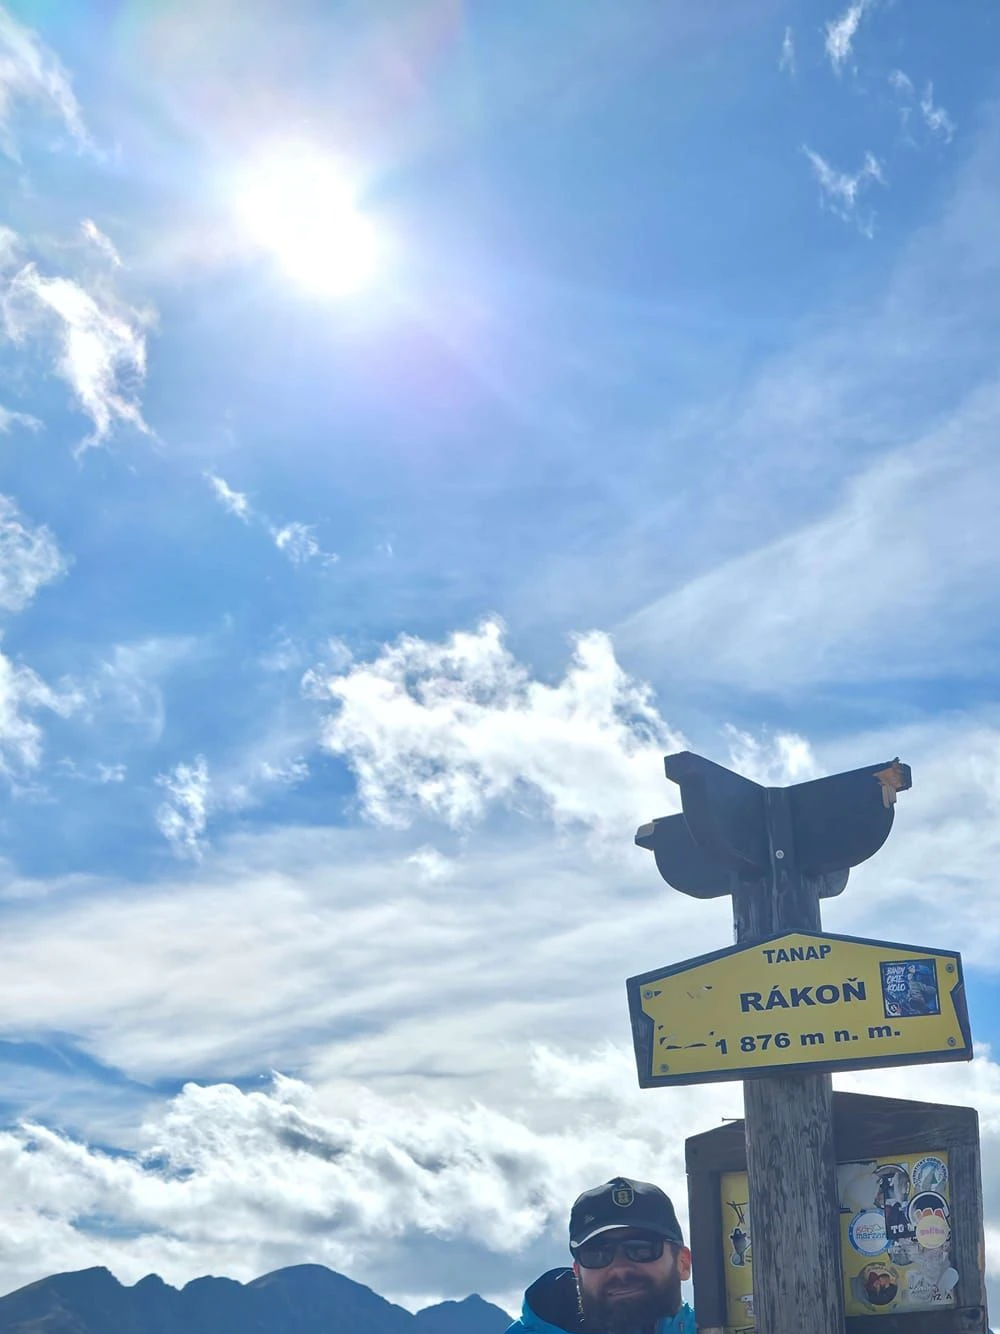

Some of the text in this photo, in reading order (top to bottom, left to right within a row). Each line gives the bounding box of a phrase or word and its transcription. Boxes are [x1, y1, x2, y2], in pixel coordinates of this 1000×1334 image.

[763, 944, 832, 964] TANAP
[739, 977, 867, 1013] RÁKOŇ
[740, 1032, 791, 1053] 876
[800, 1031, 825, 1046] m
[834, 1029, 858, 1043] n.
[868, 1024, 901, 1039] m.
